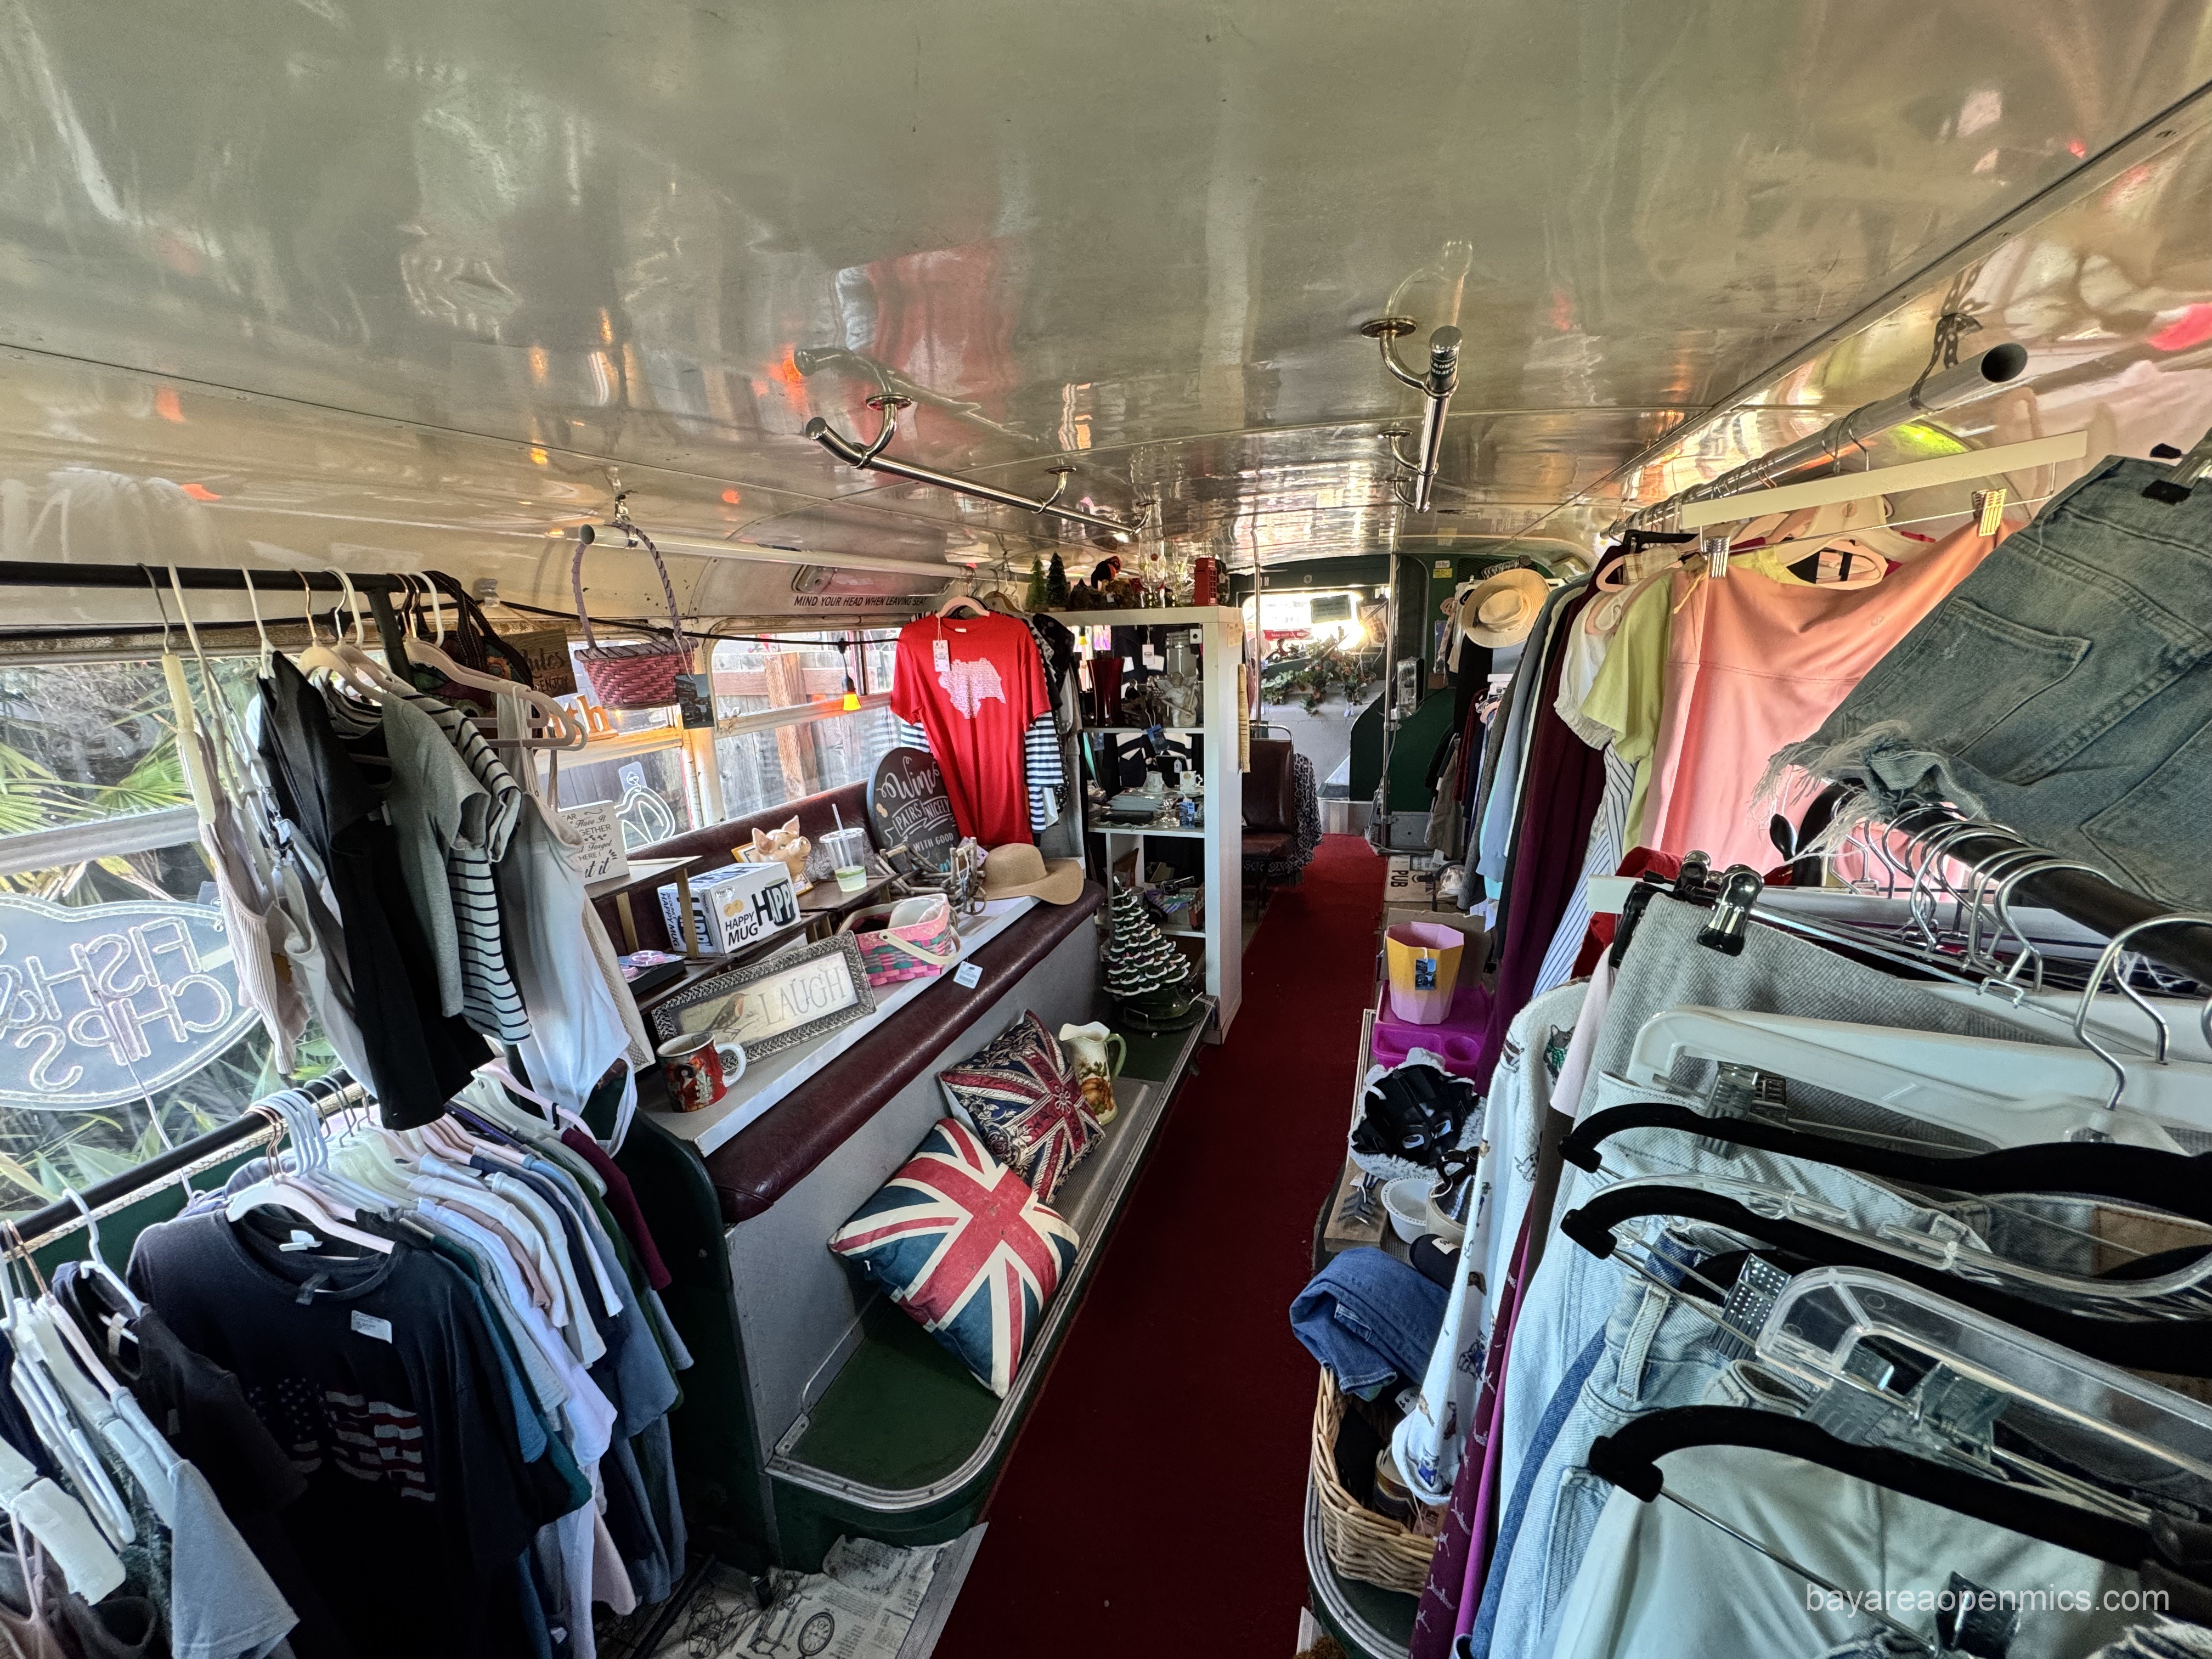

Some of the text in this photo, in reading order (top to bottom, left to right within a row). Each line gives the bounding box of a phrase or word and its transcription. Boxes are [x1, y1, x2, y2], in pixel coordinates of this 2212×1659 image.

[794, 596, 927, 606] MIND YOUR HEAD WHEN LEAVING SEAT
[521, 648, 565, 671] ules
[876, 756, 940, 799] Wine
[574, 818, 594, 828] Have
[895, 799, 950, 831] PAIRS NICELY
[588, 839, 612, 852] Forgot
[913, 832, 954, 852] WITH GOOD
[598, 857, 610, 876] it
[1391, 870, 1409, 887] PUB
[661, 893, 680, 946] HAPPY MUG
[725, 911, 755, 932] HAPPY
[728, 922, 758, 946] MUG
[758, 967, 847, 1027] LAUGH
